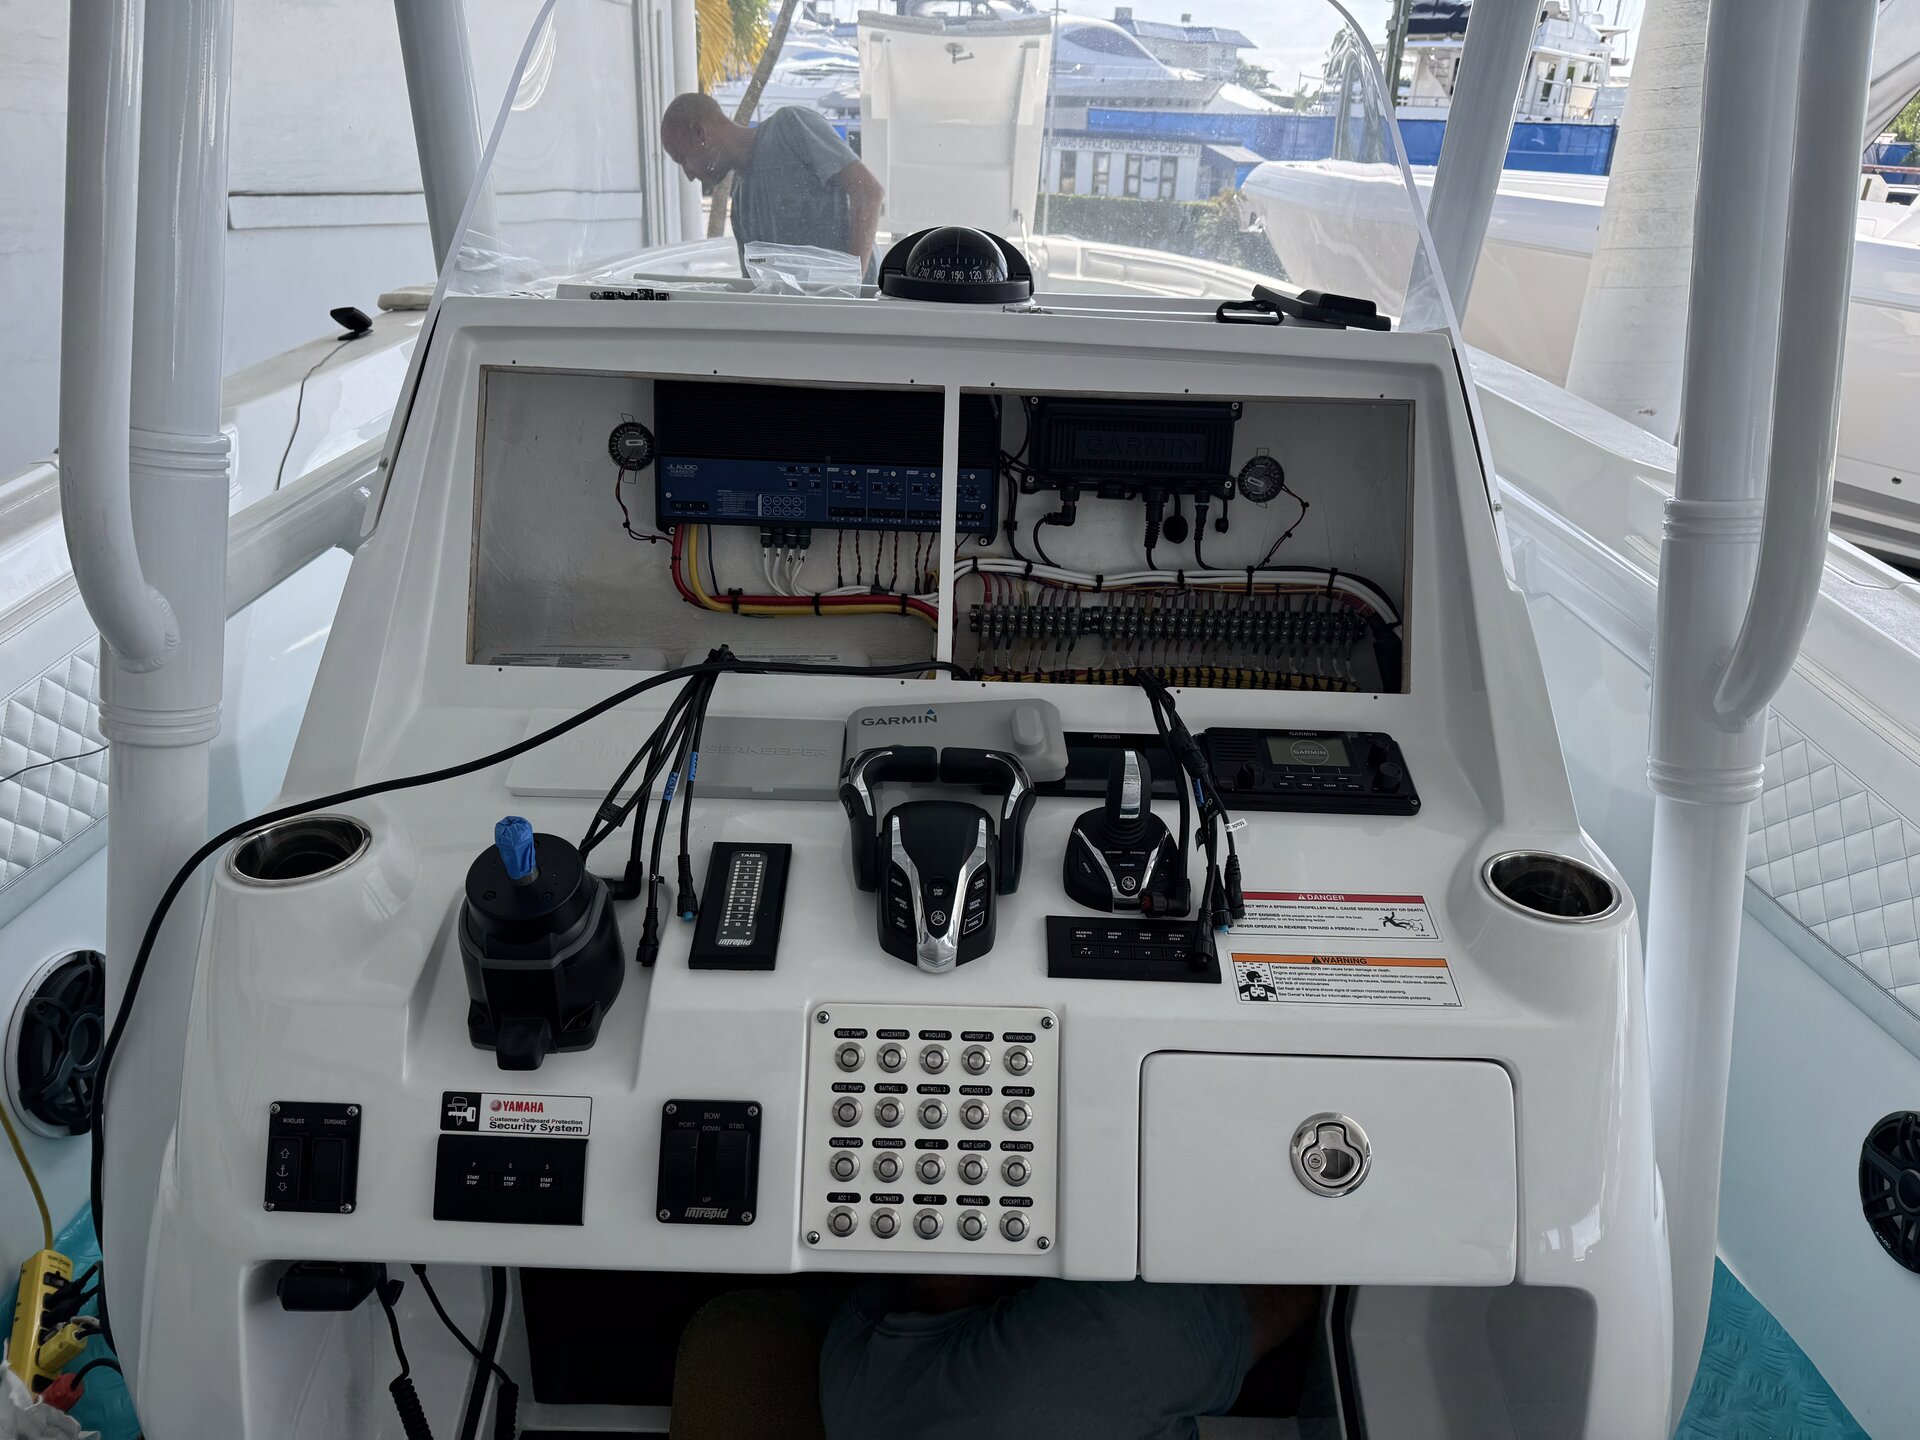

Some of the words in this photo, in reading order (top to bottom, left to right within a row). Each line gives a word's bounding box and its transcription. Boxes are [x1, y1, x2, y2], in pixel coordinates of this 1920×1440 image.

[934, 270, 945, 279] 180
[951, 271, 964, 280] 150
[969, 271, 982, 280] 120
[1086, 436, 1198, 458] GARMIN
[861, 714, 936, 726] GARMIN
[705, 744, 829, 757] SEAKEEPER
[1292, 749, 1327, 757] GARMIN
[718, 939, 752, 947] intrepid
[1321, 957, 1367, 965] WARNING
[503, 1101, 544, 1112] YAMAHA
[489, 1122, 536, 1131] Security
[540, 1123, 582, 1132] System
[684, 1207, 728, 1219] intrepid
